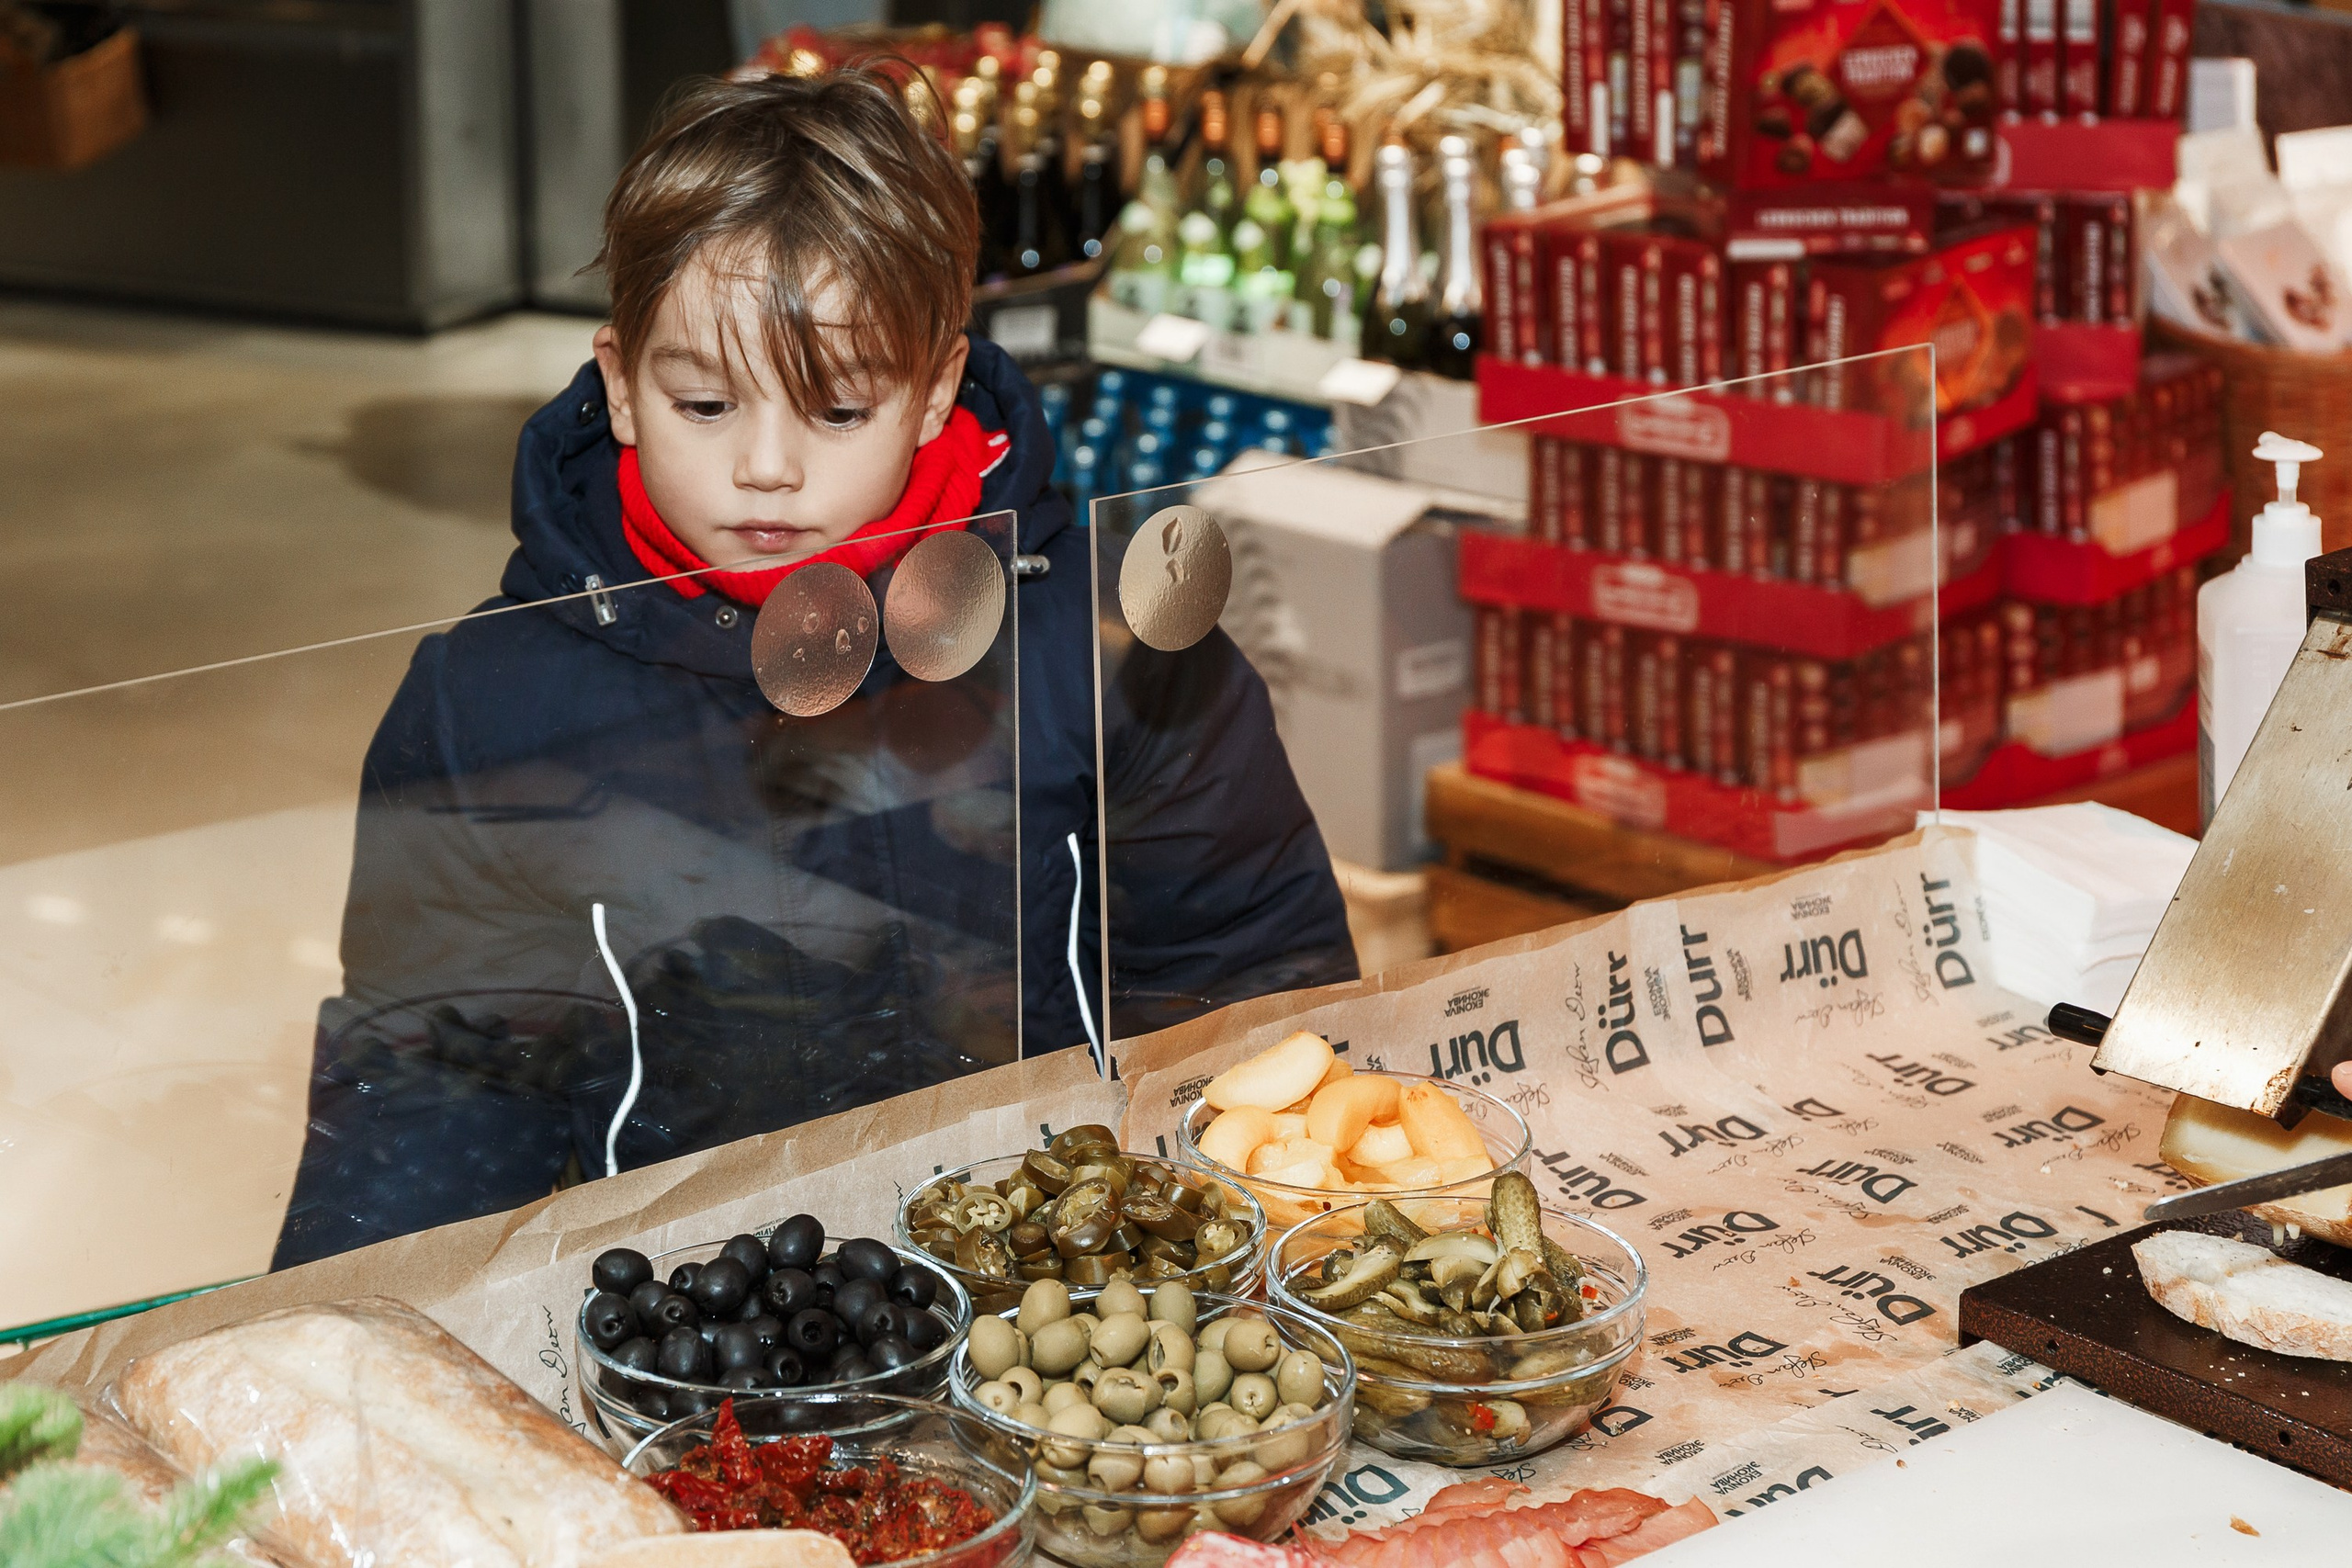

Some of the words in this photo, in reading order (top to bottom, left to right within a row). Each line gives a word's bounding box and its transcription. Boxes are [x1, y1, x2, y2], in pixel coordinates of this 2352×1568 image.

[1919, 871, 1975, 989] Dürr
[1780, 929, 1869, 988] Dürr
[1598, 951, 1652, 1076] Dürr
[1429, 1020, 1527, 1087] Dürr
[1865, 1054, 1977, 1097] Dürr
[1170, 1090, 1204, 1108] KONIVA
[1992, 1105, 2107, 1149] Dürr
[1532, 1148, 1648, 1210] Dürr
[1659, 1210, 1781, 1259] Dürr
[1939, 1211, 2060, 1259] Dürr
[1805, 1265, 1937, 1326] Dürr
[1660, 1330, 1790, 1374] Dürr
[1709, 1461, 1761, 1490] ЭКОНИВА
[1713, 1470, 1763, 1495] EKONIVA
